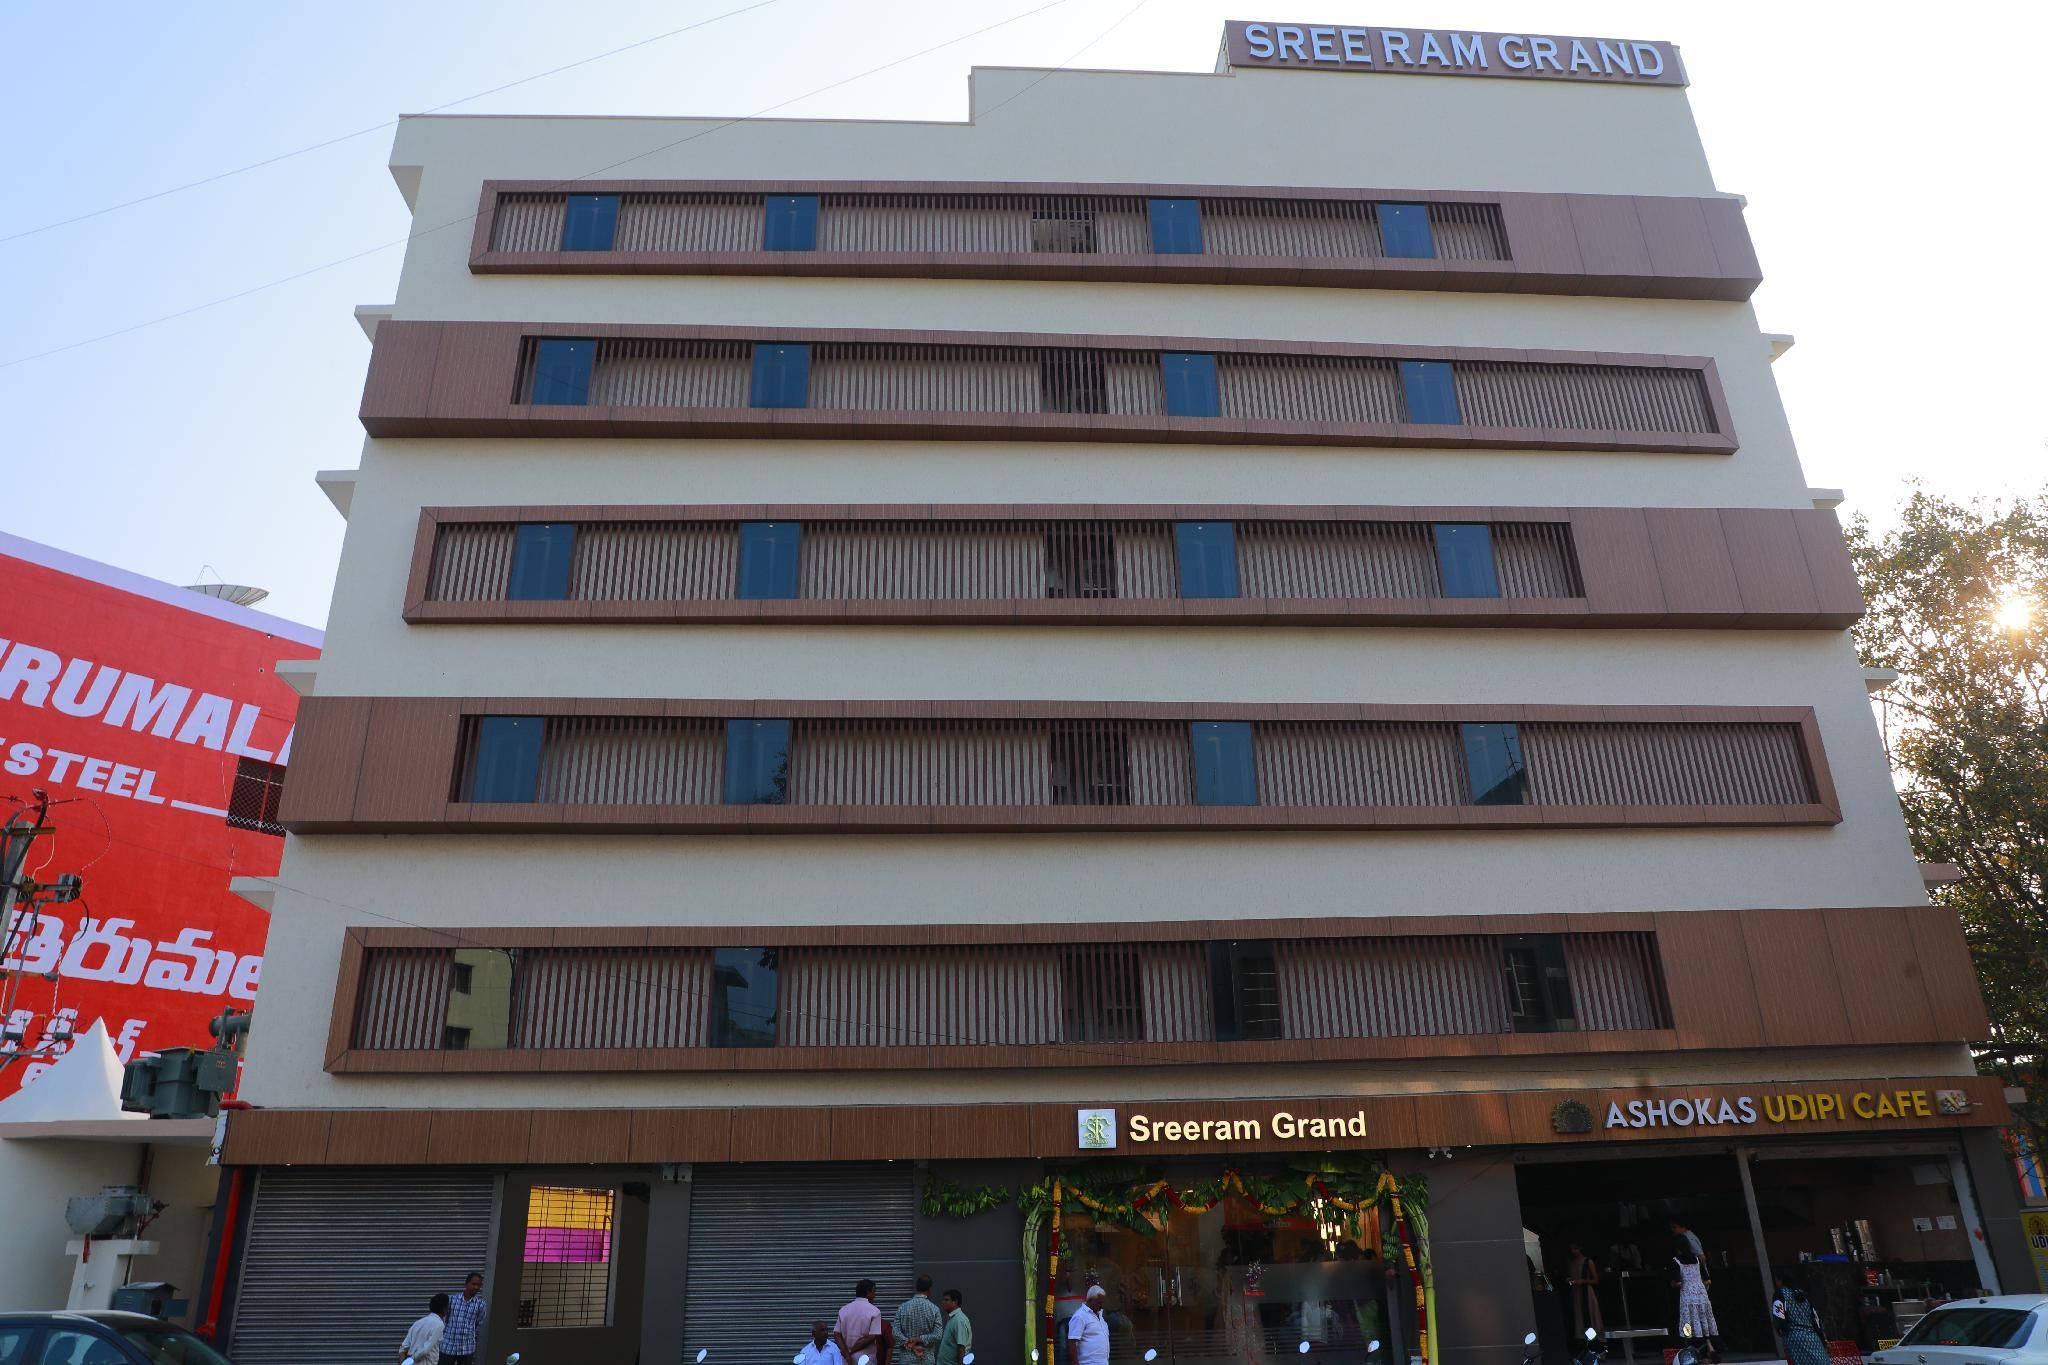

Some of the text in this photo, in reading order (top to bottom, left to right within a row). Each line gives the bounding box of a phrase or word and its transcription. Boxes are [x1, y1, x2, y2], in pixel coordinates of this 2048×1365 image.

[1244, 23, 1665, 77] SREE RAM GRAND
[0, 637, 295, 766] RUMAL
[4, 742, 166, 805] STEEL
[1129, 1110, 1367, 1142] Sreeram Grand
[1605, 1090, 1932, 1129] ASHOKAS UDIPI CAFE
